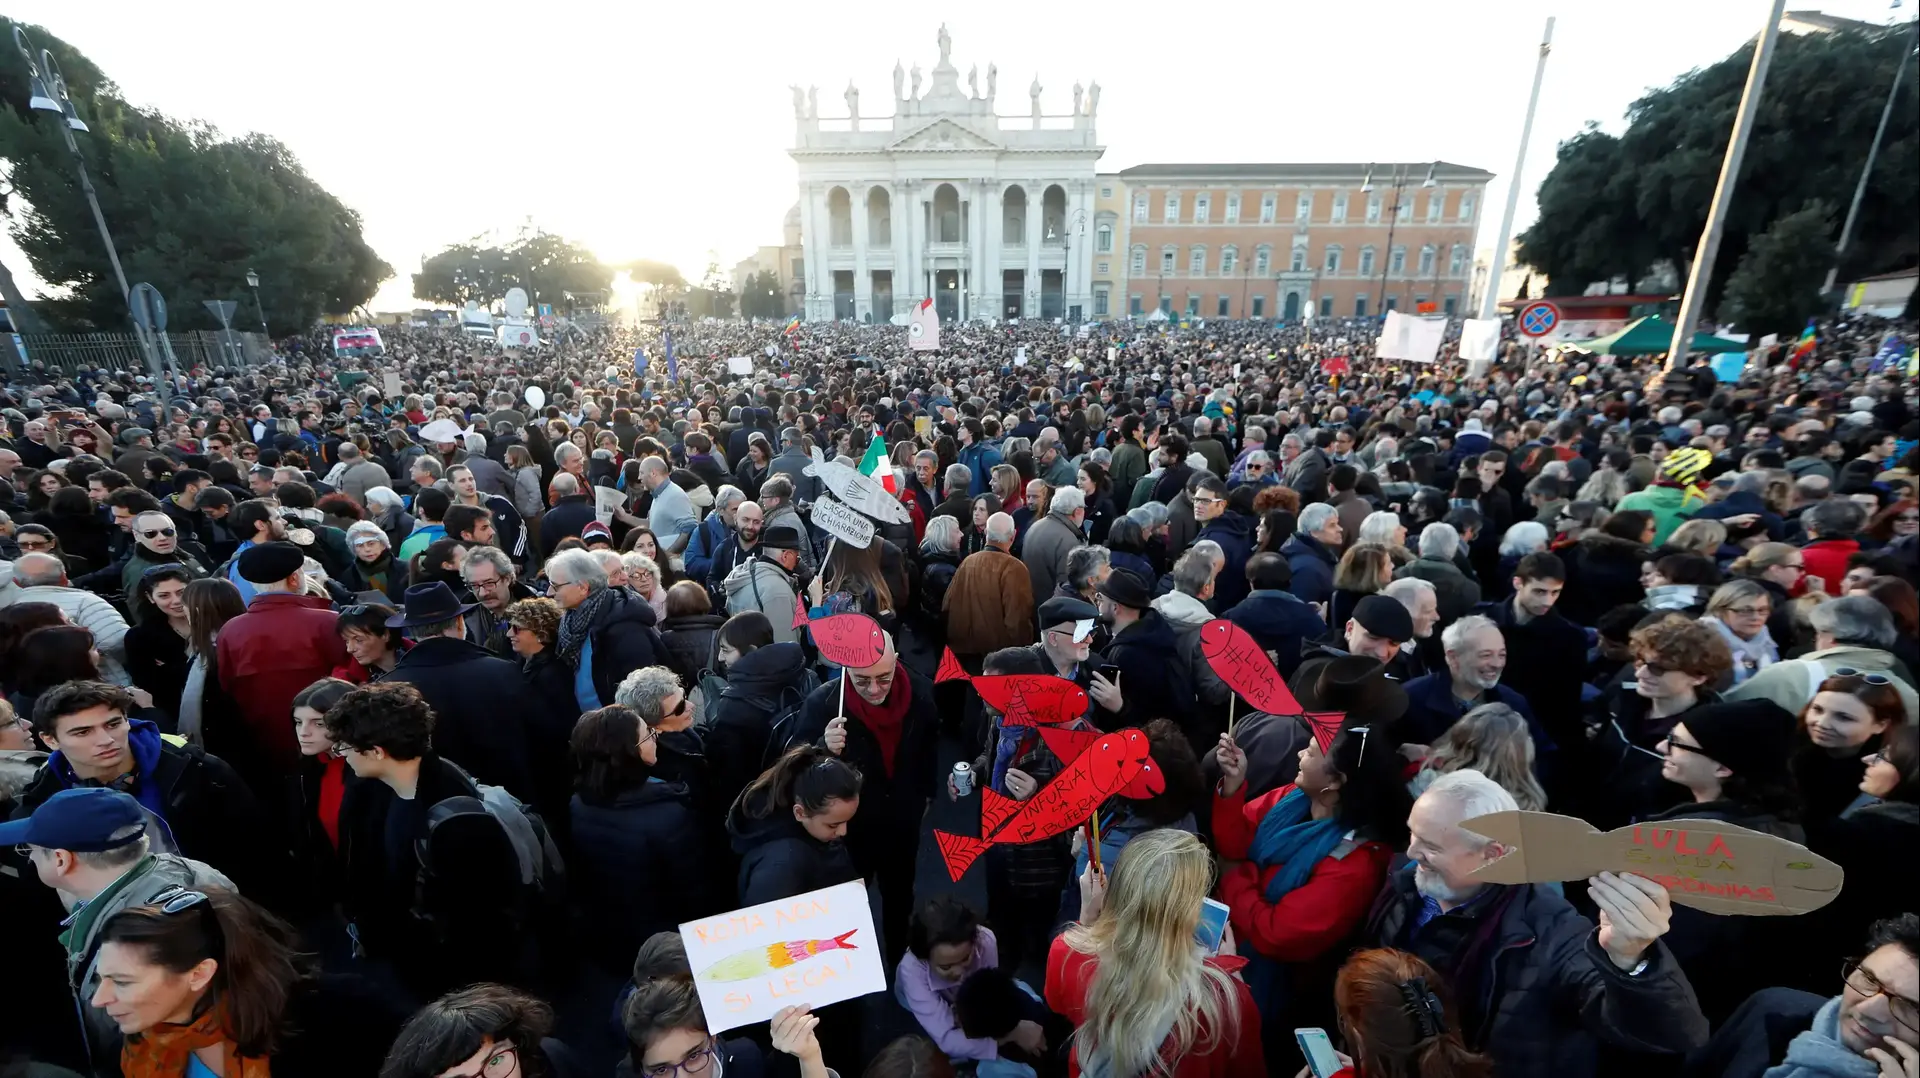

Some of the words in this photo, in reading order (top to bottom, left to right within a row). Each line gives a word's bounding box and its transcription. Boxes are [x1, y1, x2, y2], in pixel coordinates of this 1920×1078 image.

[813, 507, 871, 544] DICHIARAZIONE
[823, 501, 851, 522] LASCIA
[852, 517, 869, 532] UNA
[1041, 795, 1100, 837] BUFERA
[1051, 801, 1068, 813] LA
[1632, 826, 1735, 859] LULA
[1632, 869, 1776, 902] ARDINHAS
[694, 913, 767, 945] ROMA
[776, 895, 830, 930] NON
[723, 992, 752, 1013] SI
